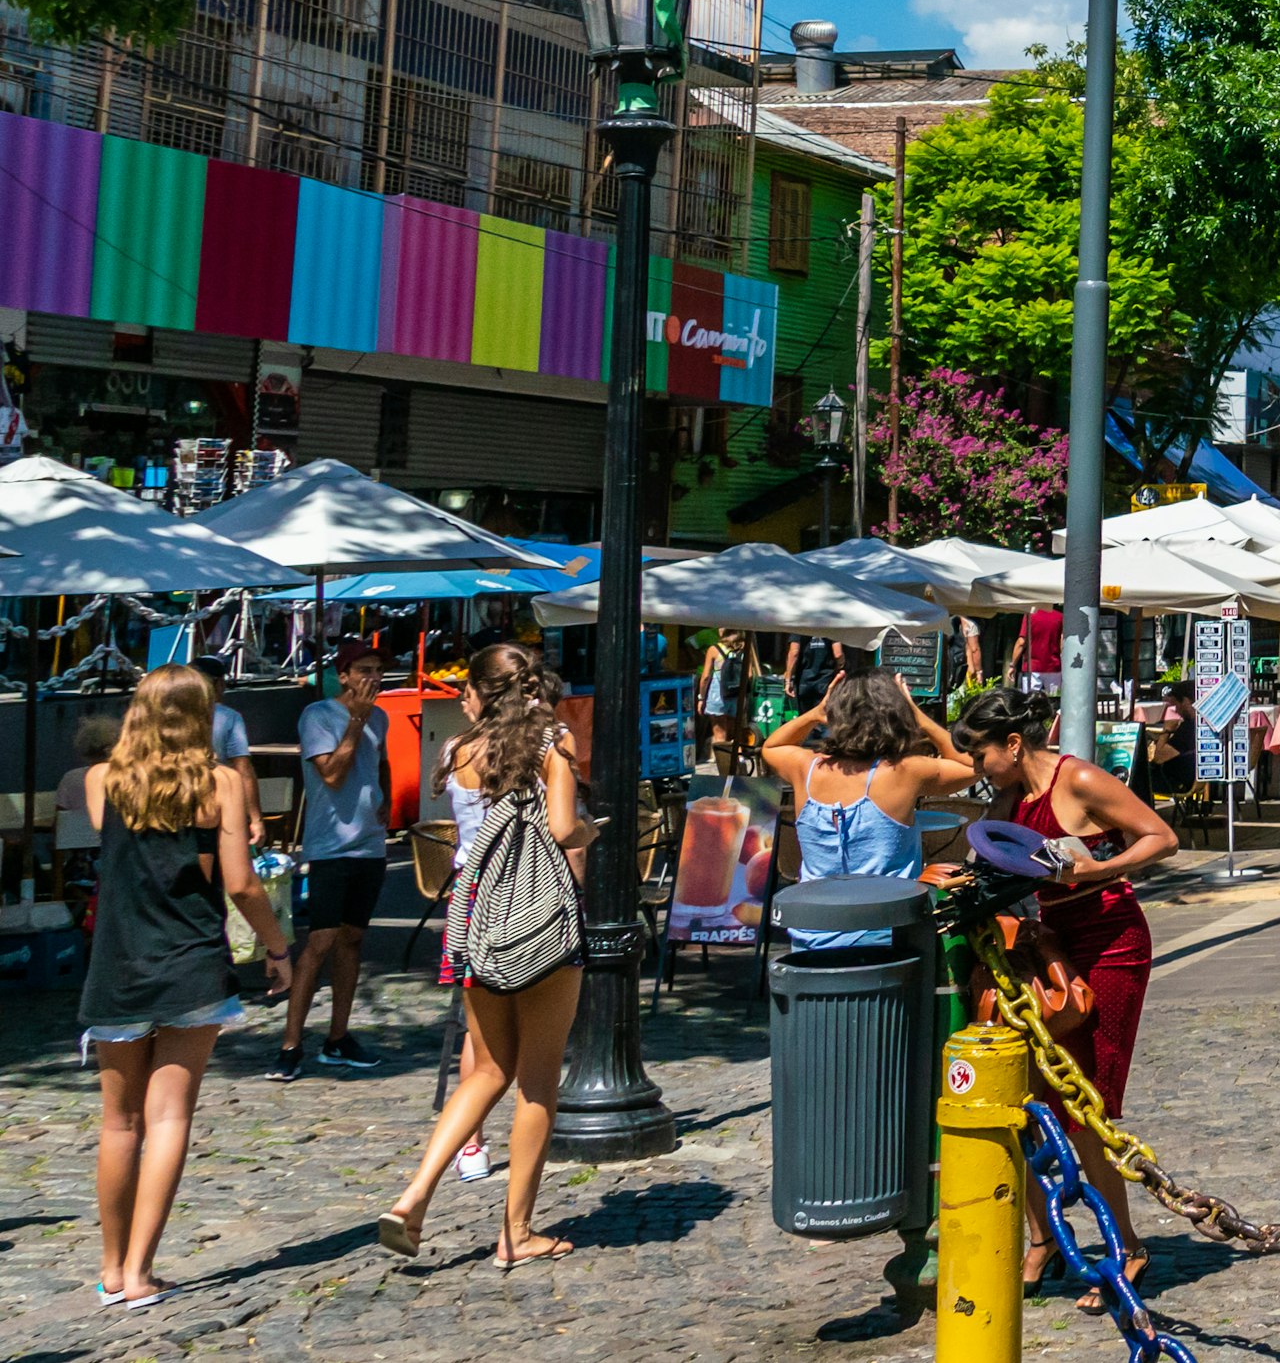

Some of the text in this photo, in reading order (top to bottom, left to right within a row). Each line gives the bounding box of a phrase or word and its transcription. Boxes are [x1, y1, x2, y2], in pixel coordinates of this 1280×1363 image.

[681, 308, 767, 369] Caminito
[691, 926, 756, 942] FRAPPÉS
[809, 1209, 890, 1226] Buenos Aires Ciudad
